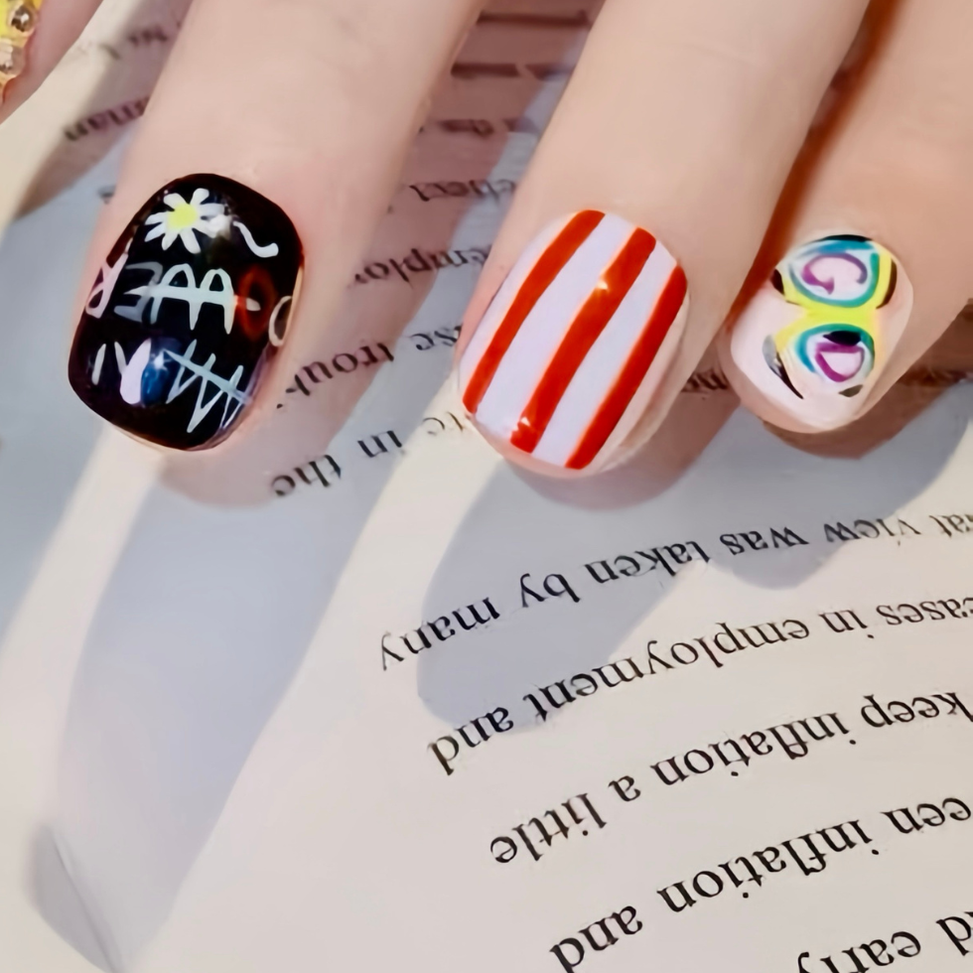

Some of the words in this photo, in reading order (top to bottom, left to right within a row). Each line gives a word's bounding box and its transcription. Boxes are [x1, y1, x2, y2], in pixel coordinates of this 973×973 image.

[357, 430, 405, 458] in
[271, 454, 342, 497] the
[719, 527, 809, 556] was
[824, 519, 921, 547] view
[584, 541, 711, 577] taken
[518, 573, 580, 608] by
[380, 597, 501, 672] many
[819, 609, 874, 639] in
[523, 622, 810, 723] employment
[860, 692, 973, 728] keep
[427, 706, 515, 777] and
[649, 712, 857, 786] inflation
[608, 775, 641, 802] a
[489, 793, 606, 864] little
[656, 819, 880, 913] inflation
[549, 906, 643, 973] and
[798, 931, 921, 973] ear
